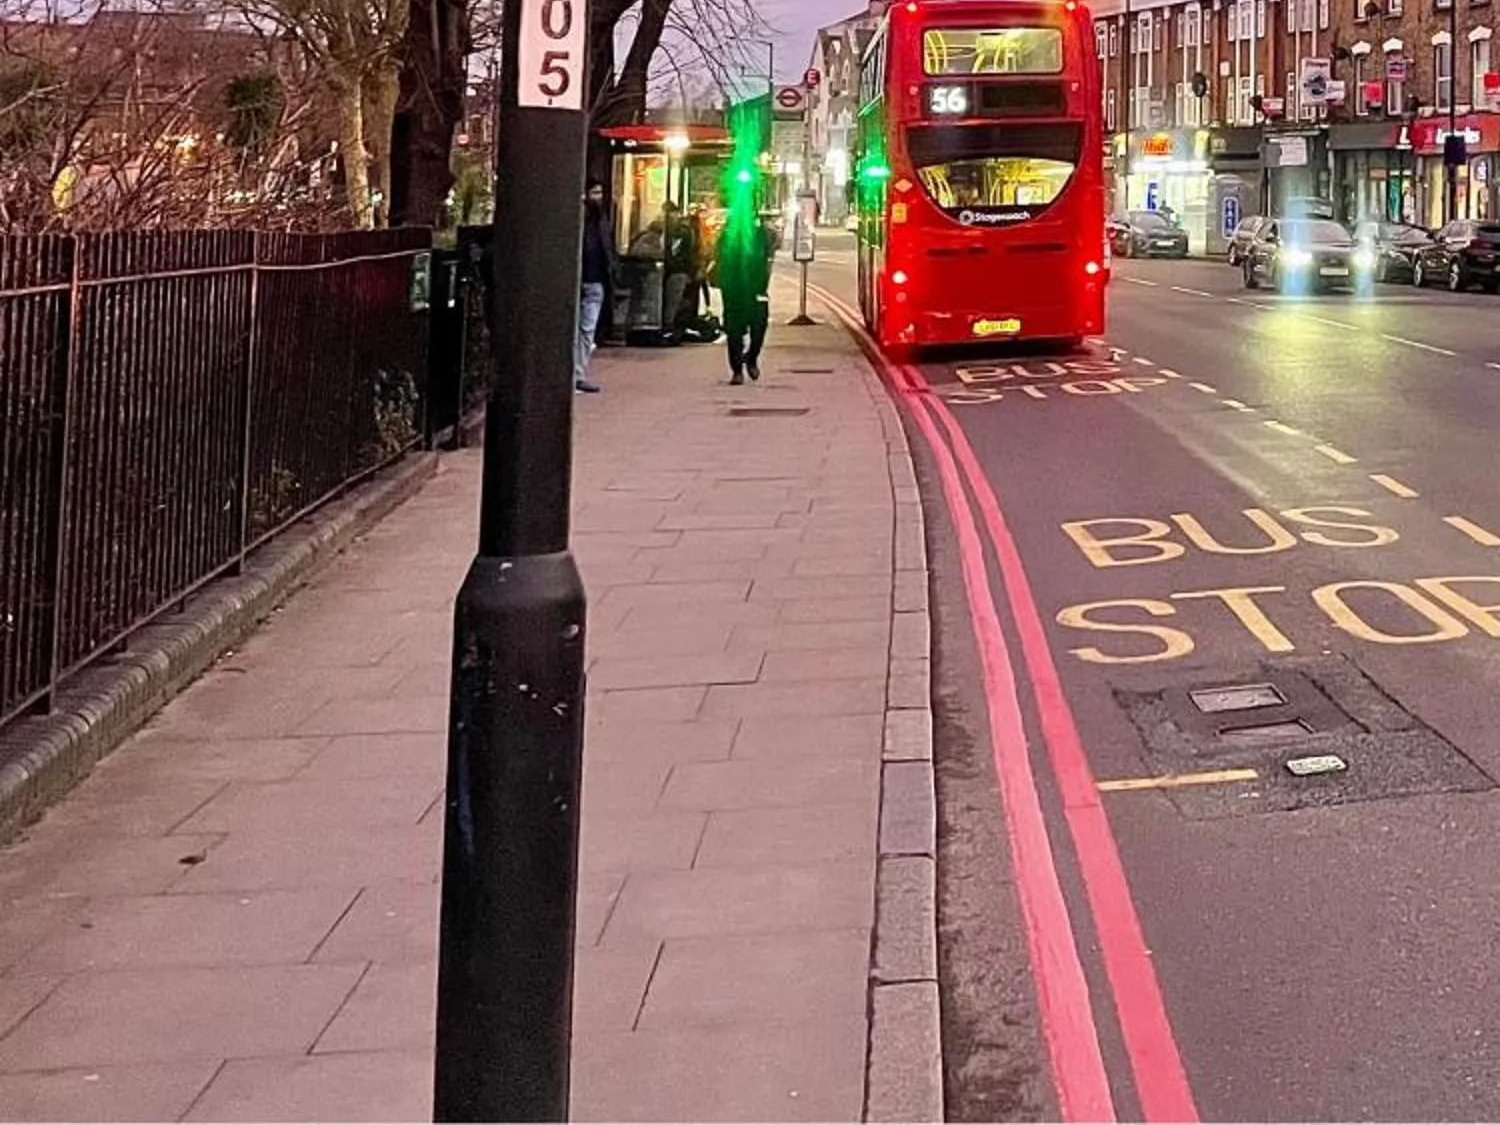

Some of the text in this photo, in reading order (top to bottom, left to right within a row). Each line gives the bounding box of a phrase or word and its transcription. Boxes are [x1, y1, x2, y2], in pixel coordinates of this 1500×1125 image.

[930, 86, 967, 113] 56
[956, 361, 1121, 384] BUS
[947, 378, 1168, 404] STOP
[1060, 507, 1400, 569] BUS
